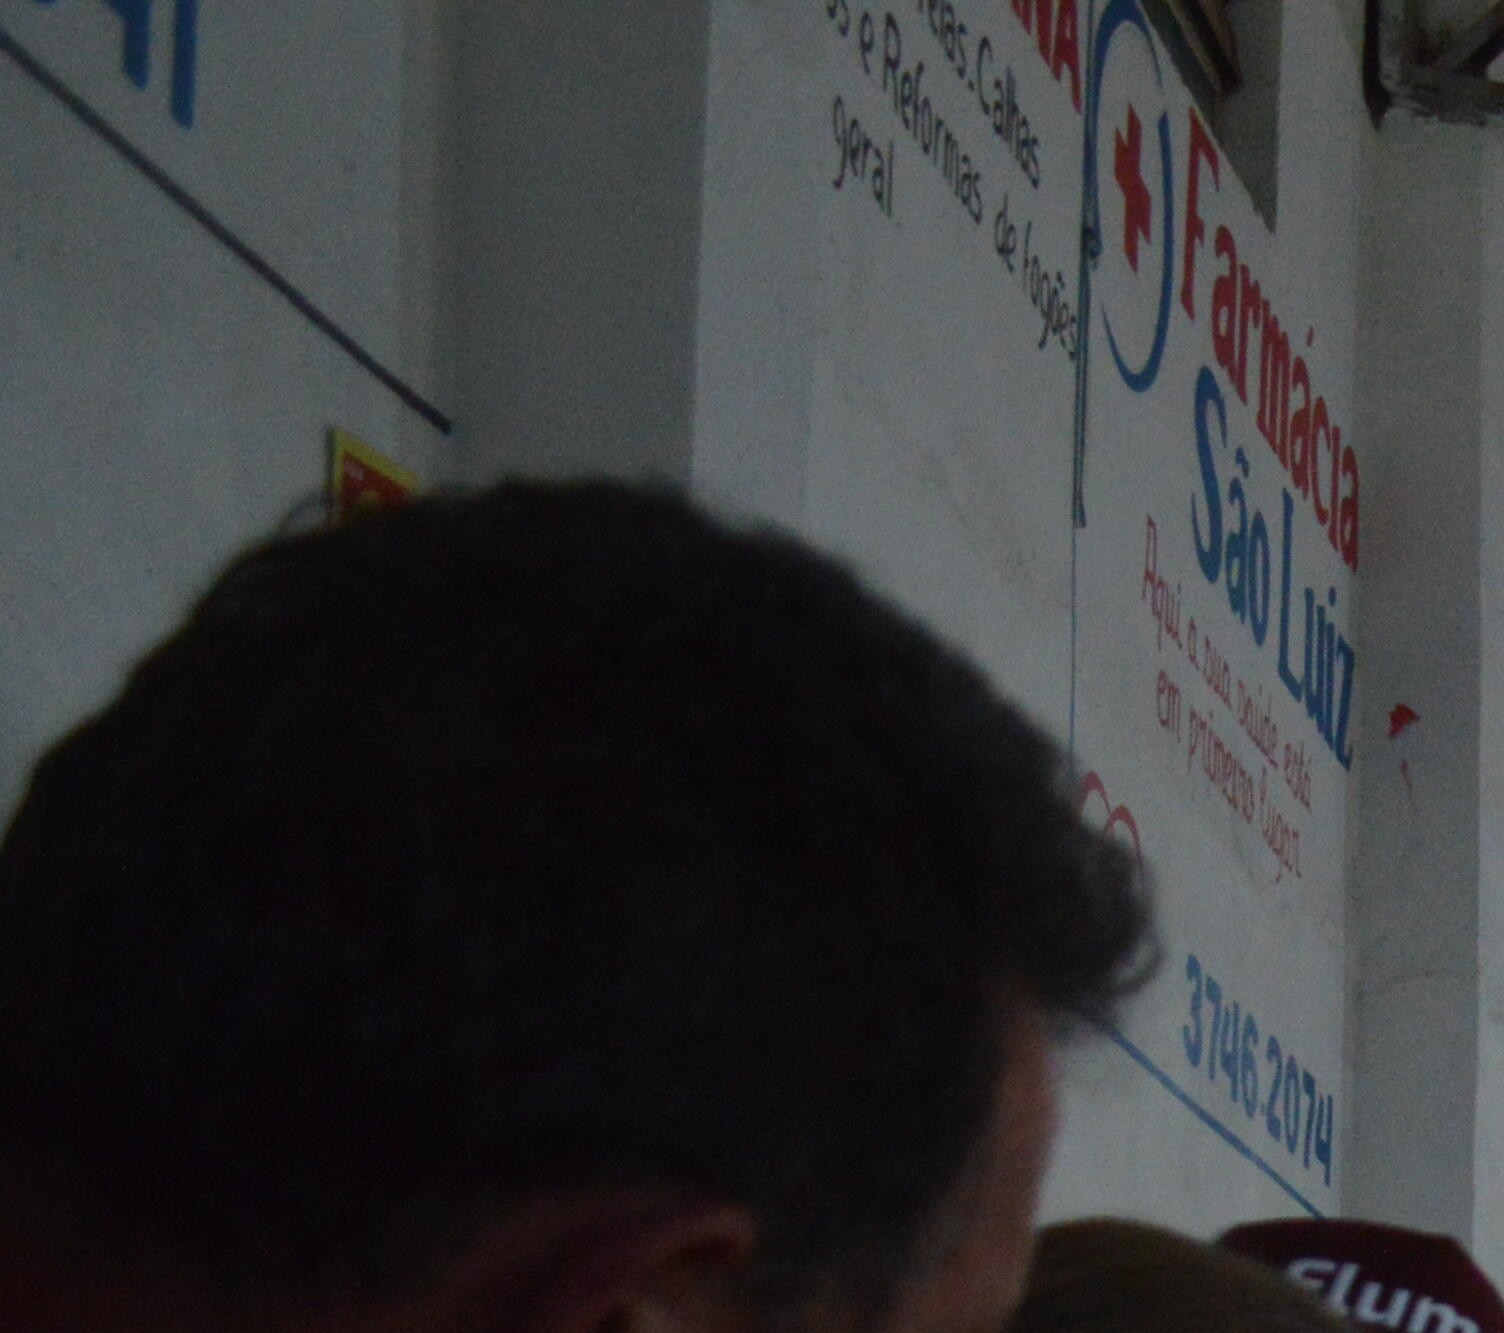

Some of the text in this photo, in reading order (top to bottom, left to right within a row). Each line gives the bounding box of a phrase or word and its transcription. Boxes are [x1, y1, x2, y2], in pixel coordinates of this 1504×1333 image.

[832, 95, 894, 218] geral
[883, 10, 982, 226] Reformas
[1180, 104, 1360, 574] Farmácia
[1190, 366, 1355, 772] São Luiz
[1182, 952, 1333, 1189] 3746.2074
